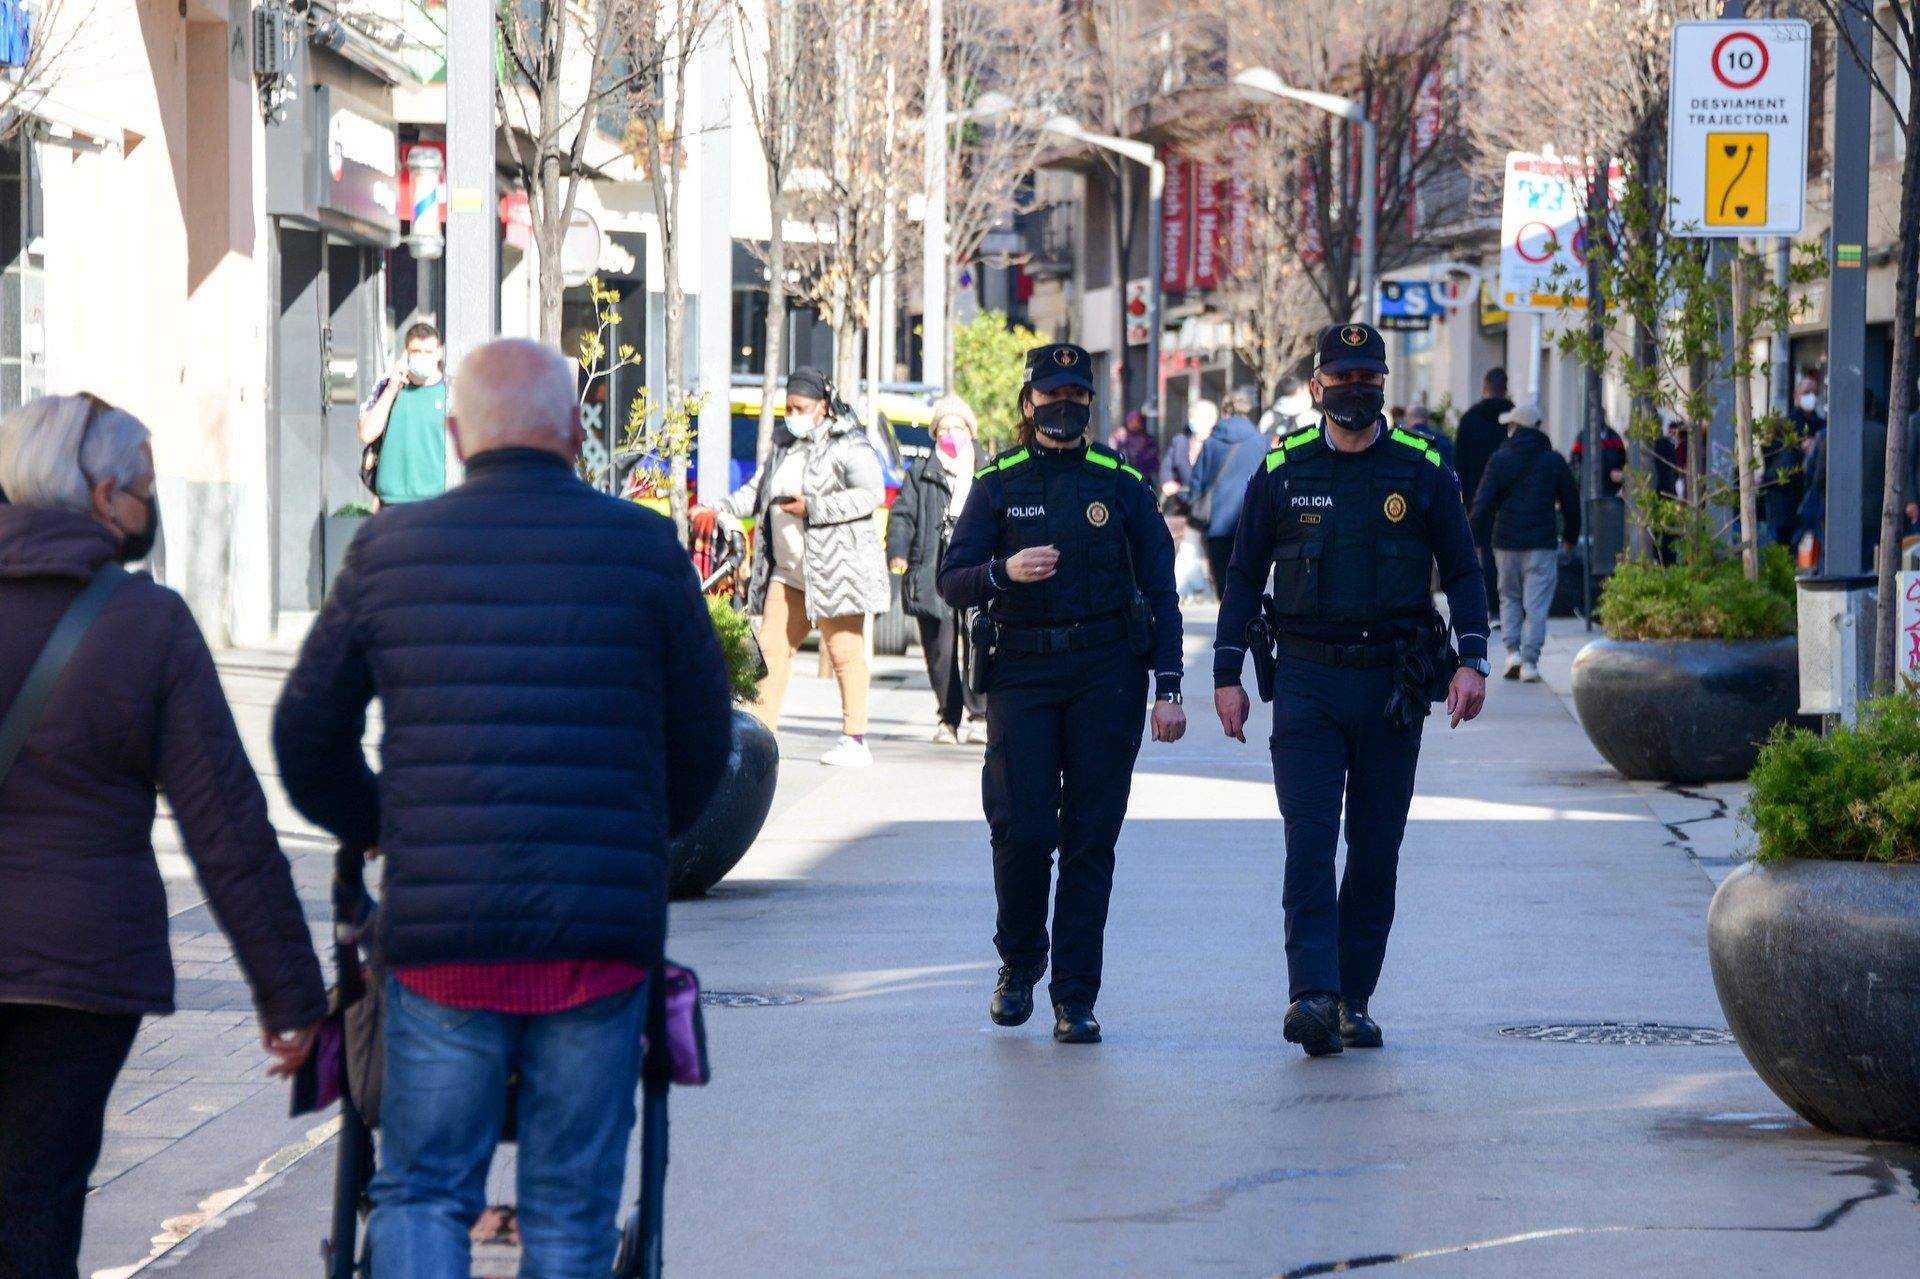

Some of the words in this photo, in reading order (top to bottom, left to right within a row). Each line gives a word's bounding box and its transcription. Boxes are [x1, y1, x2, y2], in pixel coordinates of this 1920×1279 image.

[1728, 52, 1753, 70] 10
[1690, 98, 1786, 110] DESVIAMENT
[1291, 496, 1334, 507] POLICIA
[1006, 505, 1046, 518] POLICIA
